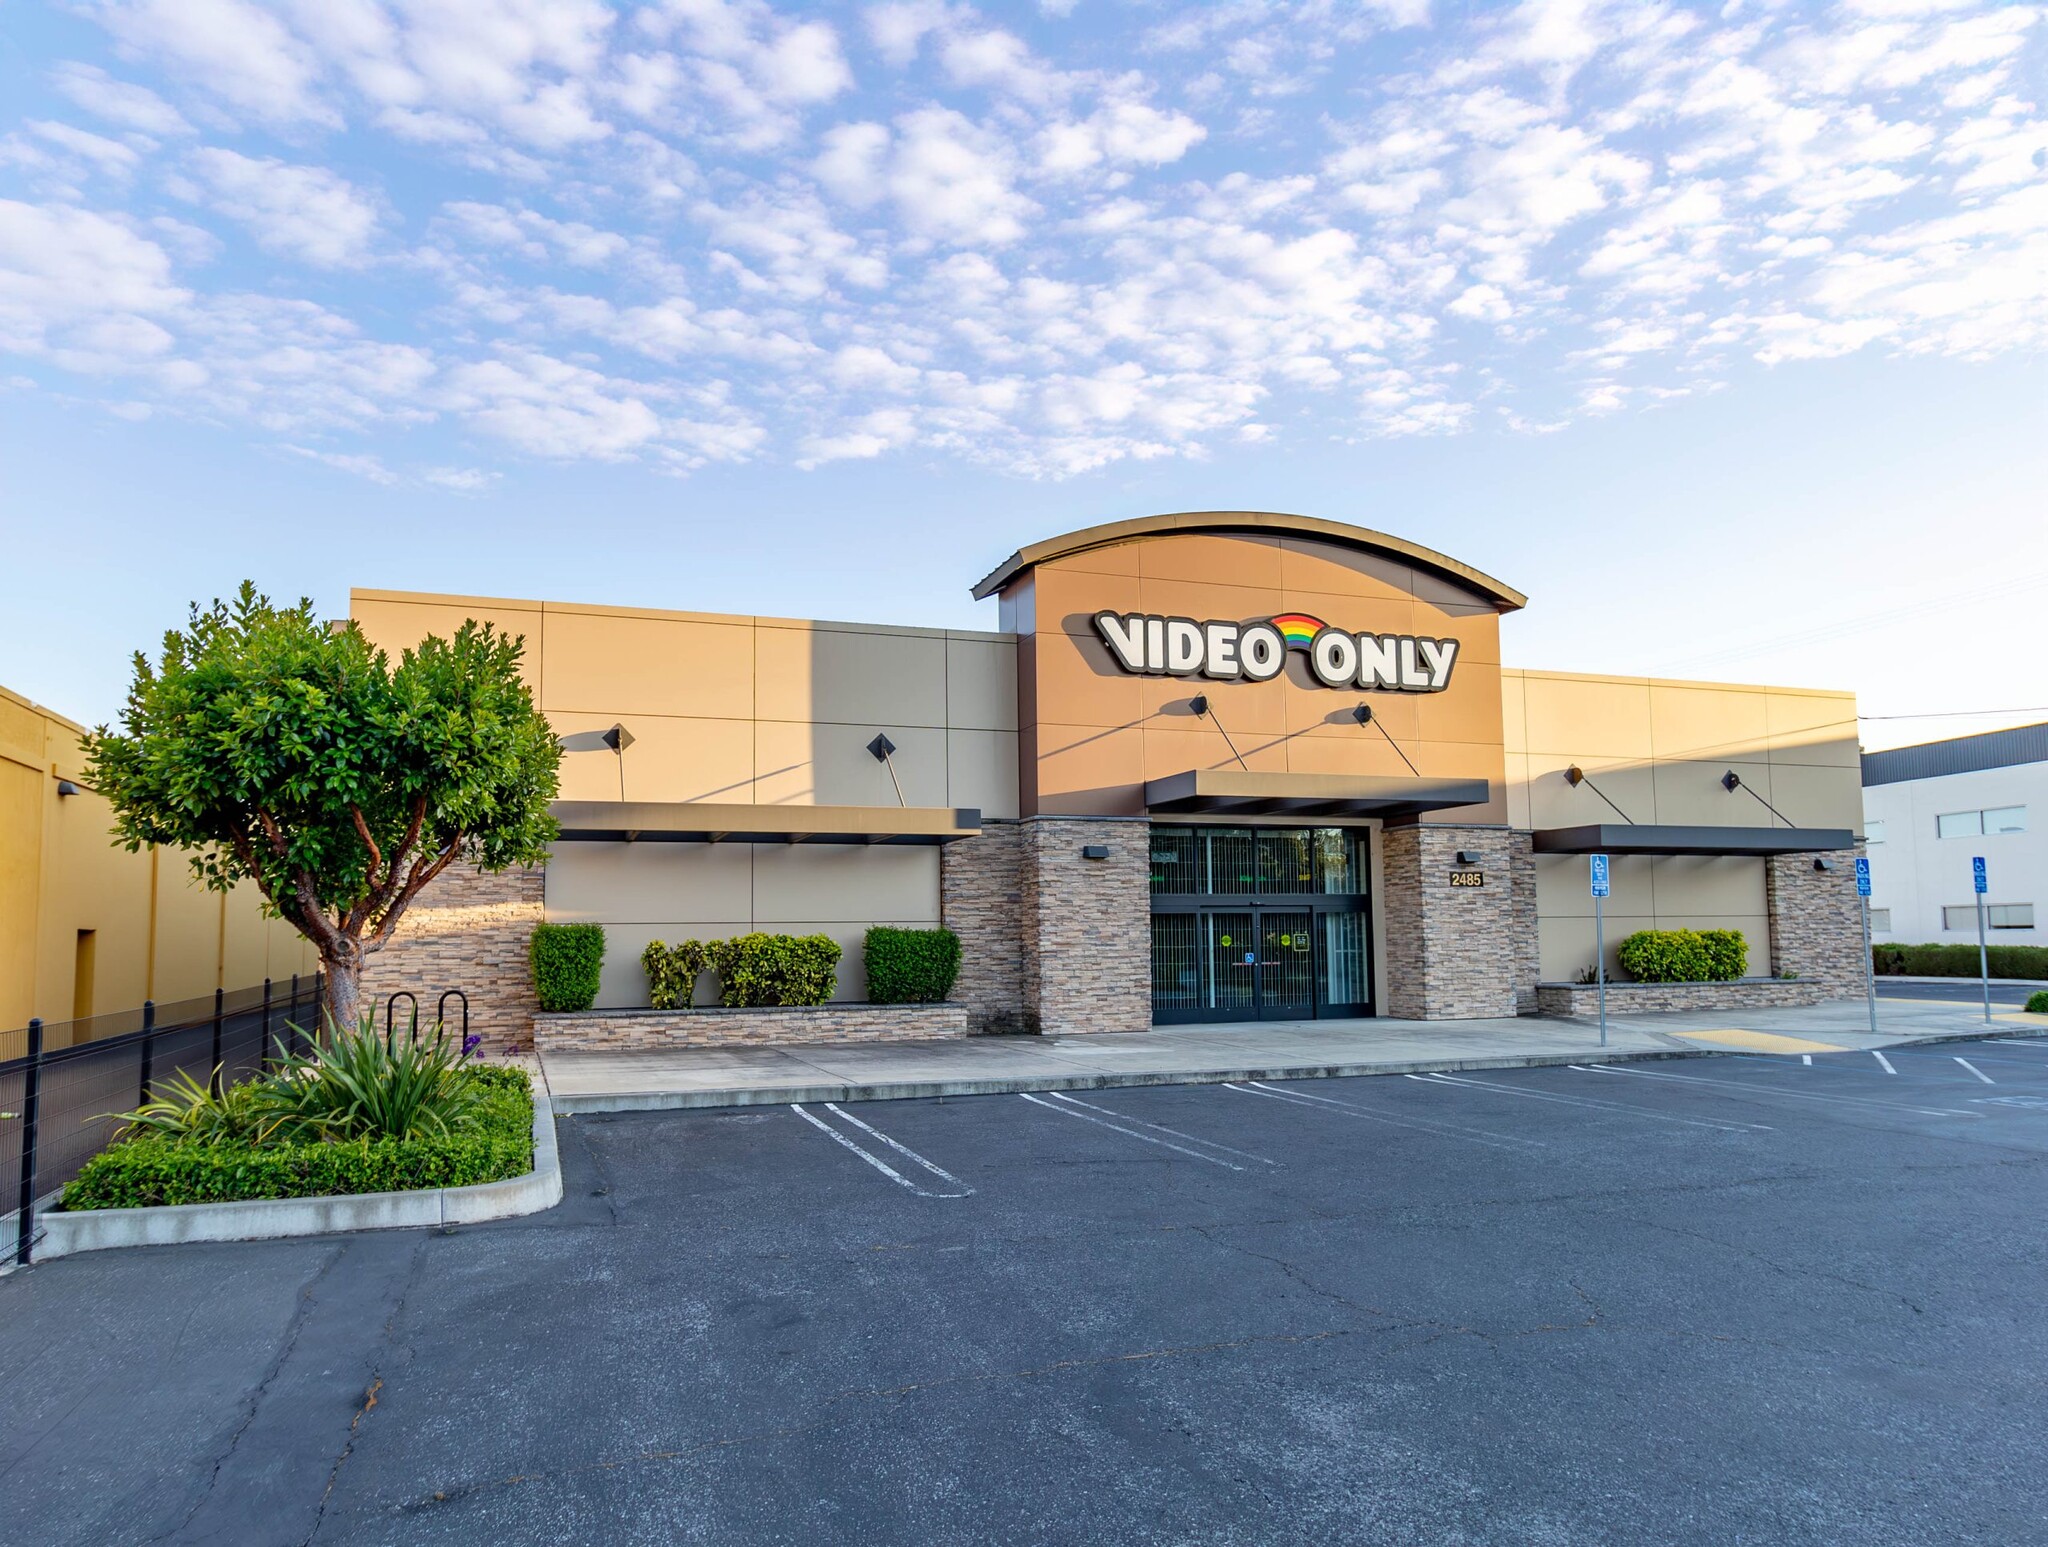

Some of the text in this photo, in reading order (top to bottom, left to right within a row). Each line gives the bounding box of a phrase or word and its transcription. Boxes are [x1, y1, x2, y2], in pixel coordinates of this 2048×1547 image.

[1098, 614, 1457, 688] VIDEO ONLY
[1452, 873, 1481, 886] 2485
